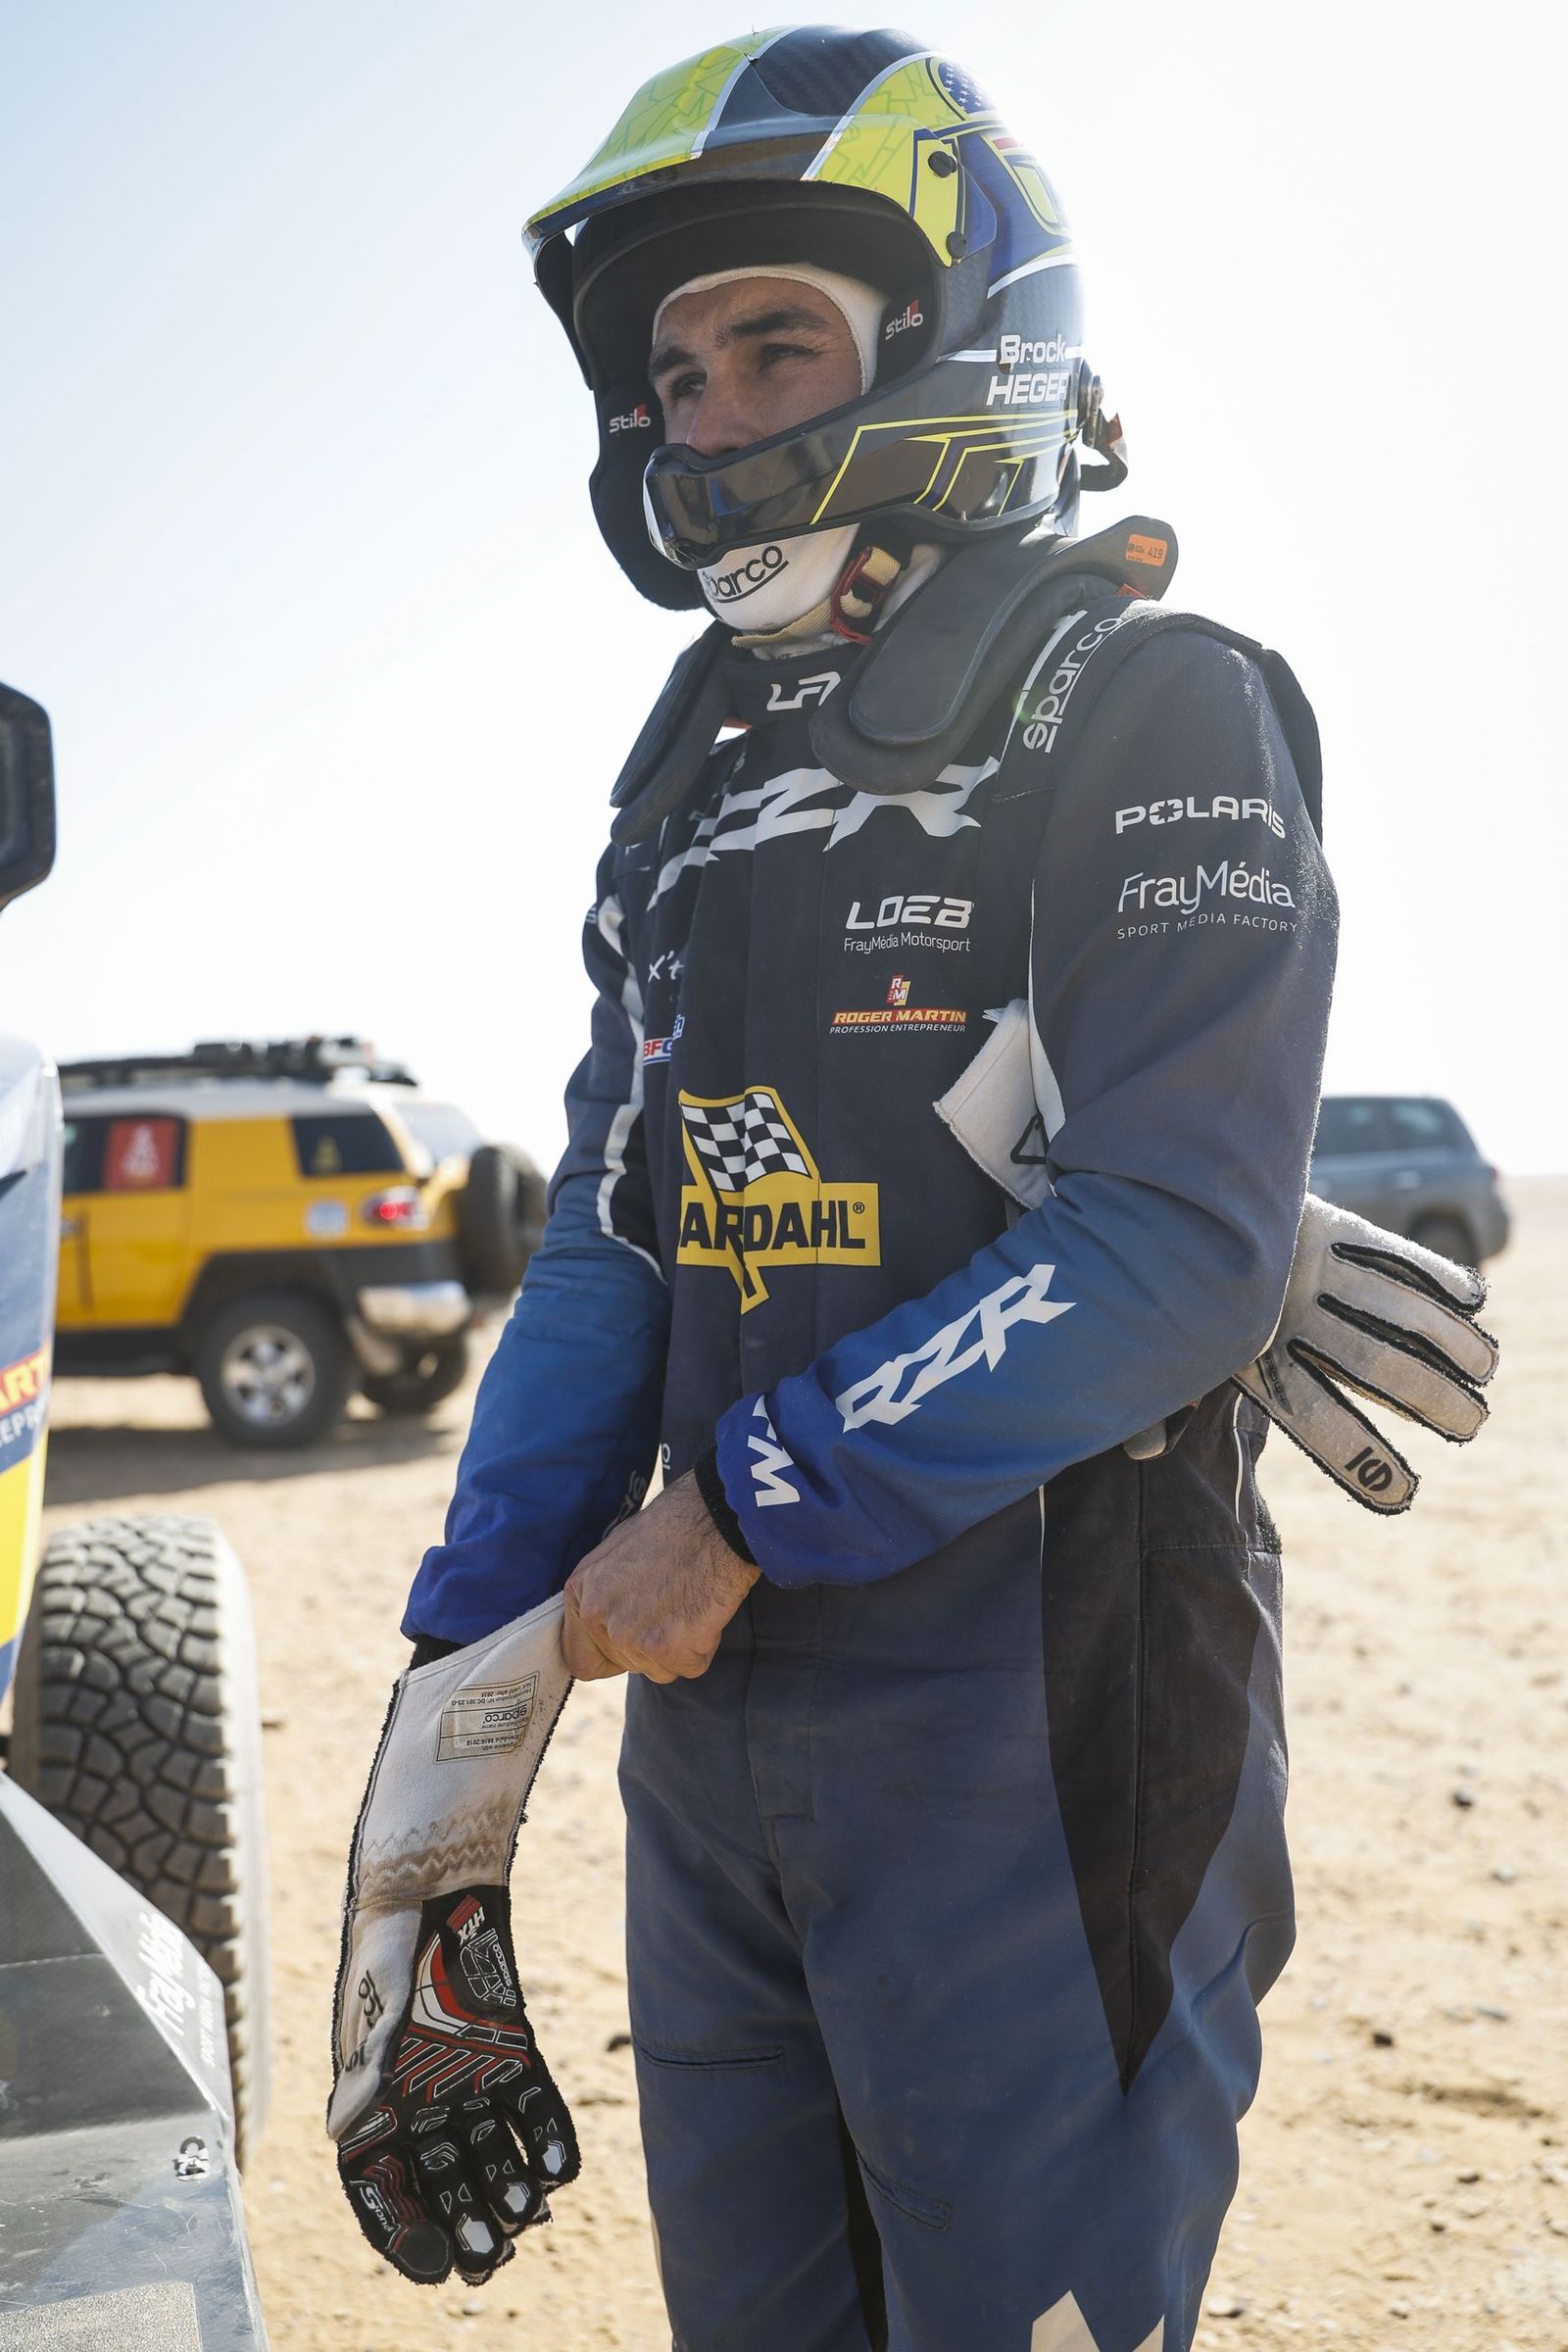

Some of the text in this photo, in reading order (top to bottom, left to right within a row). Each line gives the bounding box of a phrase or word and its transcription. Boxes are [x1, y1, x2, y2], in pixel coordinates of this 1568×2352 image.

[884, 305, 924, 340] stilo
[1000, 333, 1066, 364] Brock
[986, 371, 1069, 406] HEGER
[609, 406, 651, 433] stilo
[703, 545, 789, 604] parco
[1022, 617, 1123, 754] sparco
[1115, 795, 1286, 839] POLARIS
[1117, 860, 1297, 915] FrayMédia
[846, 895, 974, 929] LOEB
[1117, 912, 1298, 940] SPORT MEDIA FACTORY
[844, 931, 971, 955] FrayMédia Motorsport
[829, 1023, 966, 1035] PROFESSION ENTREPRENEUR
[833, 1009, 967, 1023] ROGER MARTIN
[834, 1263, 1077, 1434] RZR
[484, 1703, 529, 1723] sparco
[492, 1942, 514, 1987] sparco
